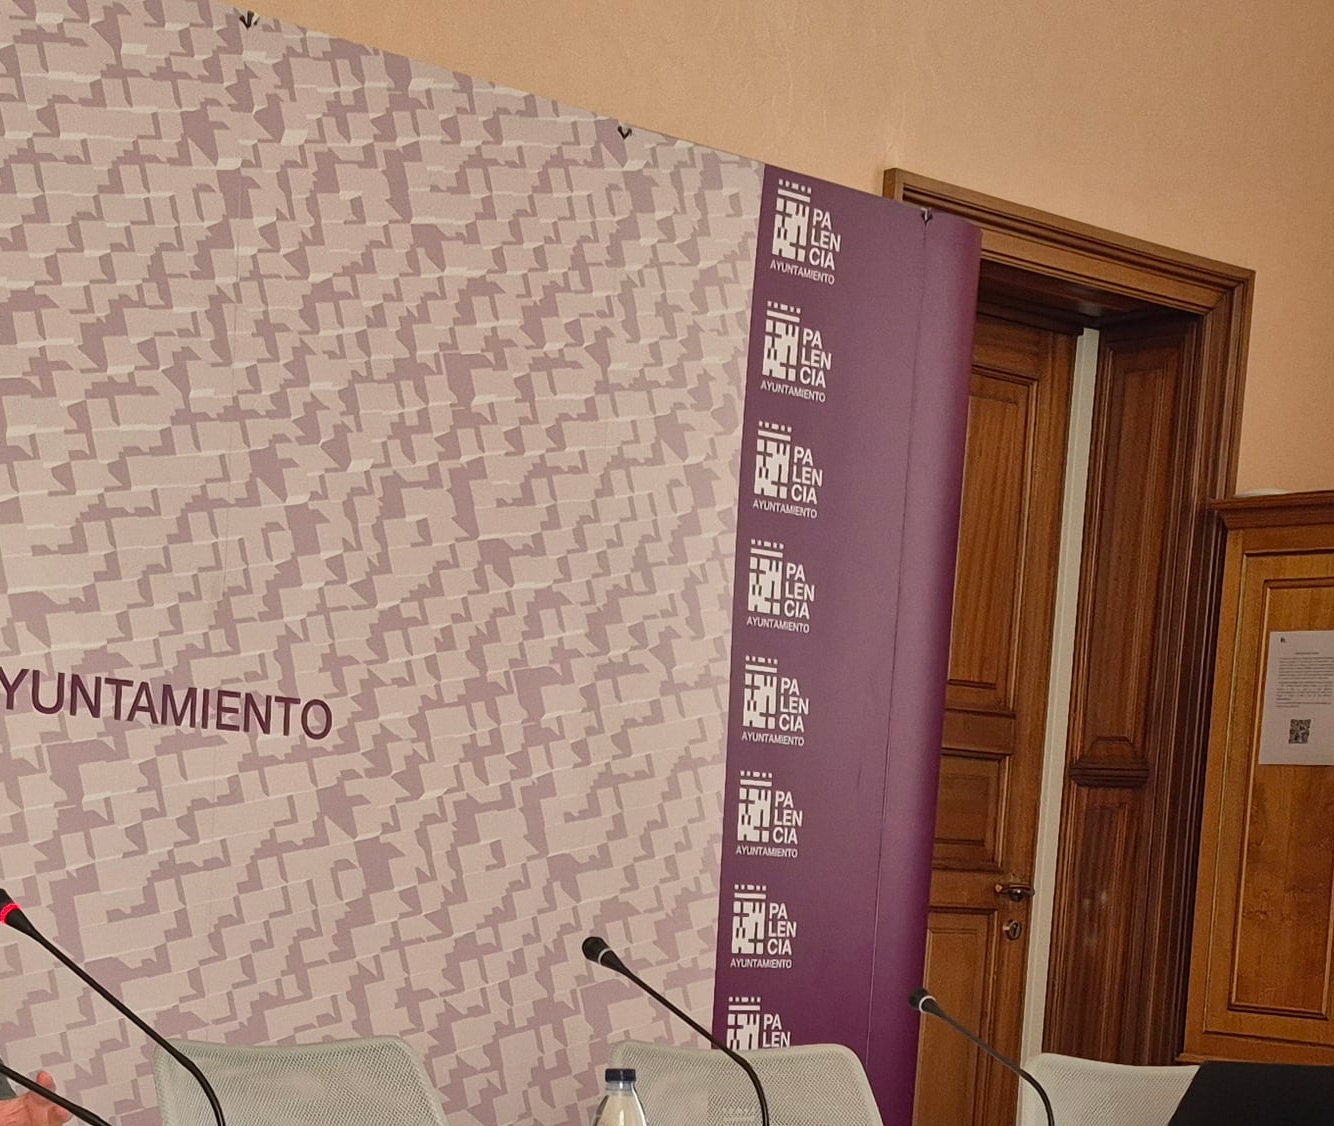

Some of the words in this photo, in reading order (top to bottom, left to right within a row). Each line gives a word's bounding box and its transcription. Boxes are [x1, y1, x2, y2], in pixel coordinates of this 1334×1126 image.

[813, 208, 832, 230] PA
[811, 229, 841, 252] LEN
[809, 250, 835, 270] CIA
[770, 259, 835, 285] AYUNTAMIENTO
[803, 328, 822, 349] PA
[801, 347, 832, 370] LEN
[800, 368, 826, 388] CIA
[761, 380, 826, 402] AYUNTAMIENTO
[794, 446, 813, 466] PA
[792, 465, 823, 487] LEN
[791, 485, 817, 504] CIA
[753, 499, 817, 519] AYUNTAMIENTO
[786, 563, 805, 582] PA
[785, 581, 815, 602] LEN
[784, 600, 810, 619] CIA
[747, 616, 809, 633] AYUNTAMIENTO
[781, 678, 799, 696] PA
[780, 696, 809, 715] LEN
[779, 714, 804, 733] CIA
[742, 731, 804, 746] AYUNTAMIENTO
[775, 791, 794, 808] PA
[774, 809, 803, 827] LEN
[773, 827, 798, 844] CIA
[736, 846, 798, 858] AYUNTAMIENTO
[769, 903, 788, 920] PA
[769, 921, 797, 938] LEN
[767, 939, 792, 955] CIA
[731, 958, 791, 968] AYUNTAMIENTO
[764, 1014, 782, 1030] PA
[763, 1032, 790, 1048] LEN
